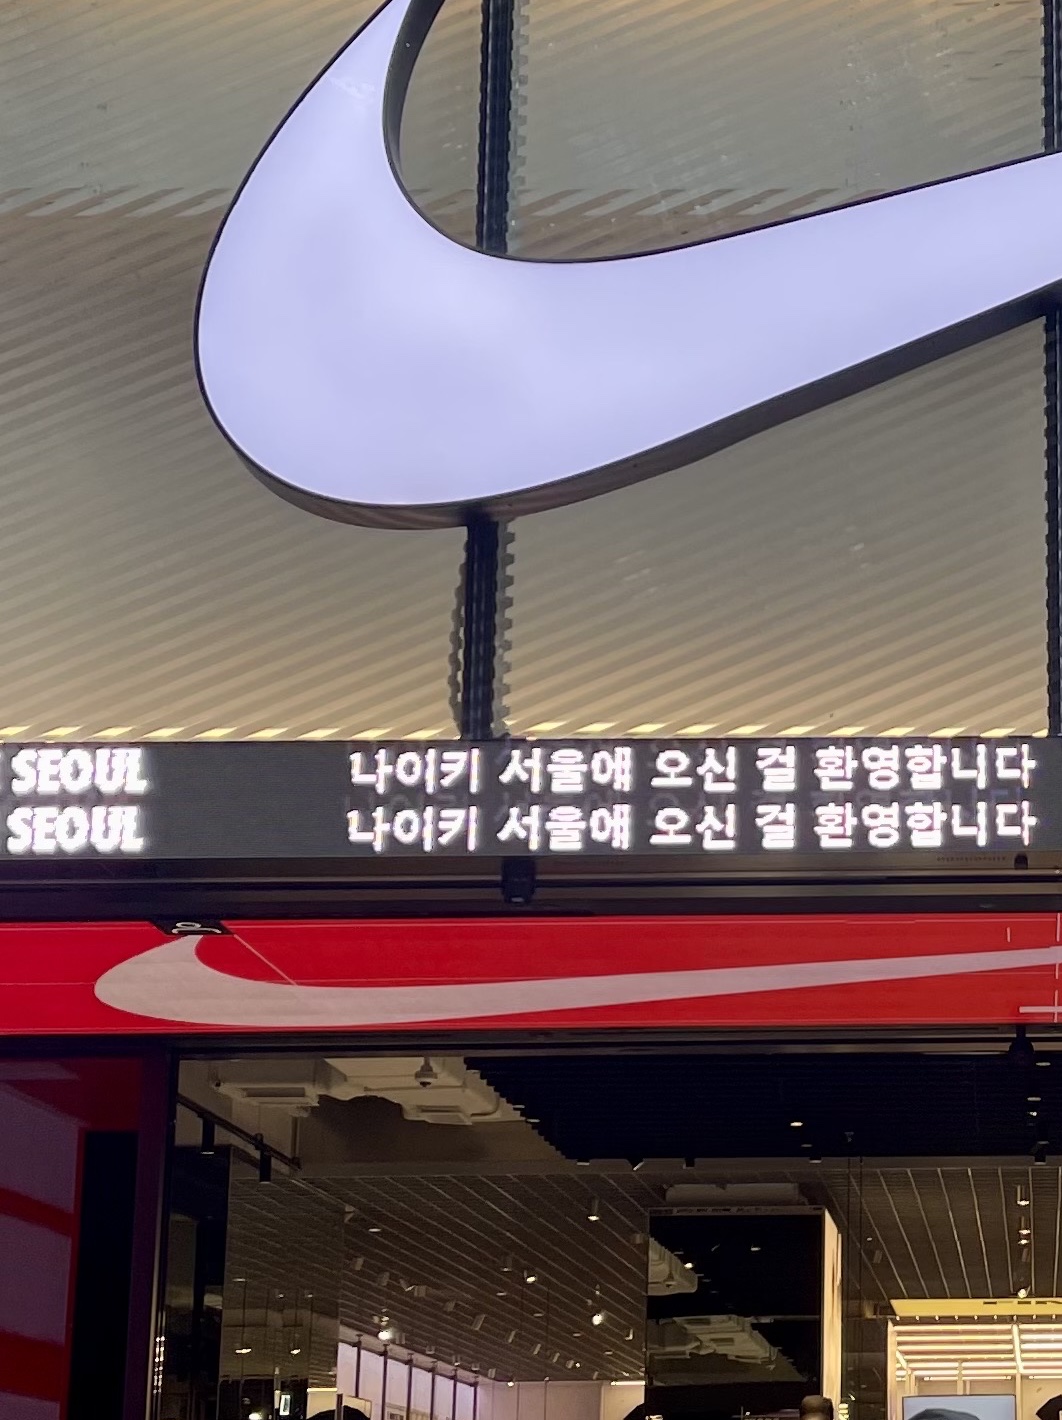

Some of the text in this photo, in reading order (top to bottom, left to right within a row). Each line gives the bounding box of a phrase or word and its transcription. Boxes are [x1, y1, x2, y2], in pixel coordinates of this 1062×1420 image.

[11, 748, 148, 795] SEOUL
[350, 748, 479, 793] 나이키
[651, 747, 736, 792] 오신
[756, 745, 796, 791] 걸
[814, 744, 1037, 790] 환영합니다
[7, 806, 144, 853] SEOUL
[347, 806, 477, 851] 나이키
[650, 804, 735, 850] 오신
[756, 803, 796, 849] 걸
[814, 801, 1037, 848] 환영합니다
